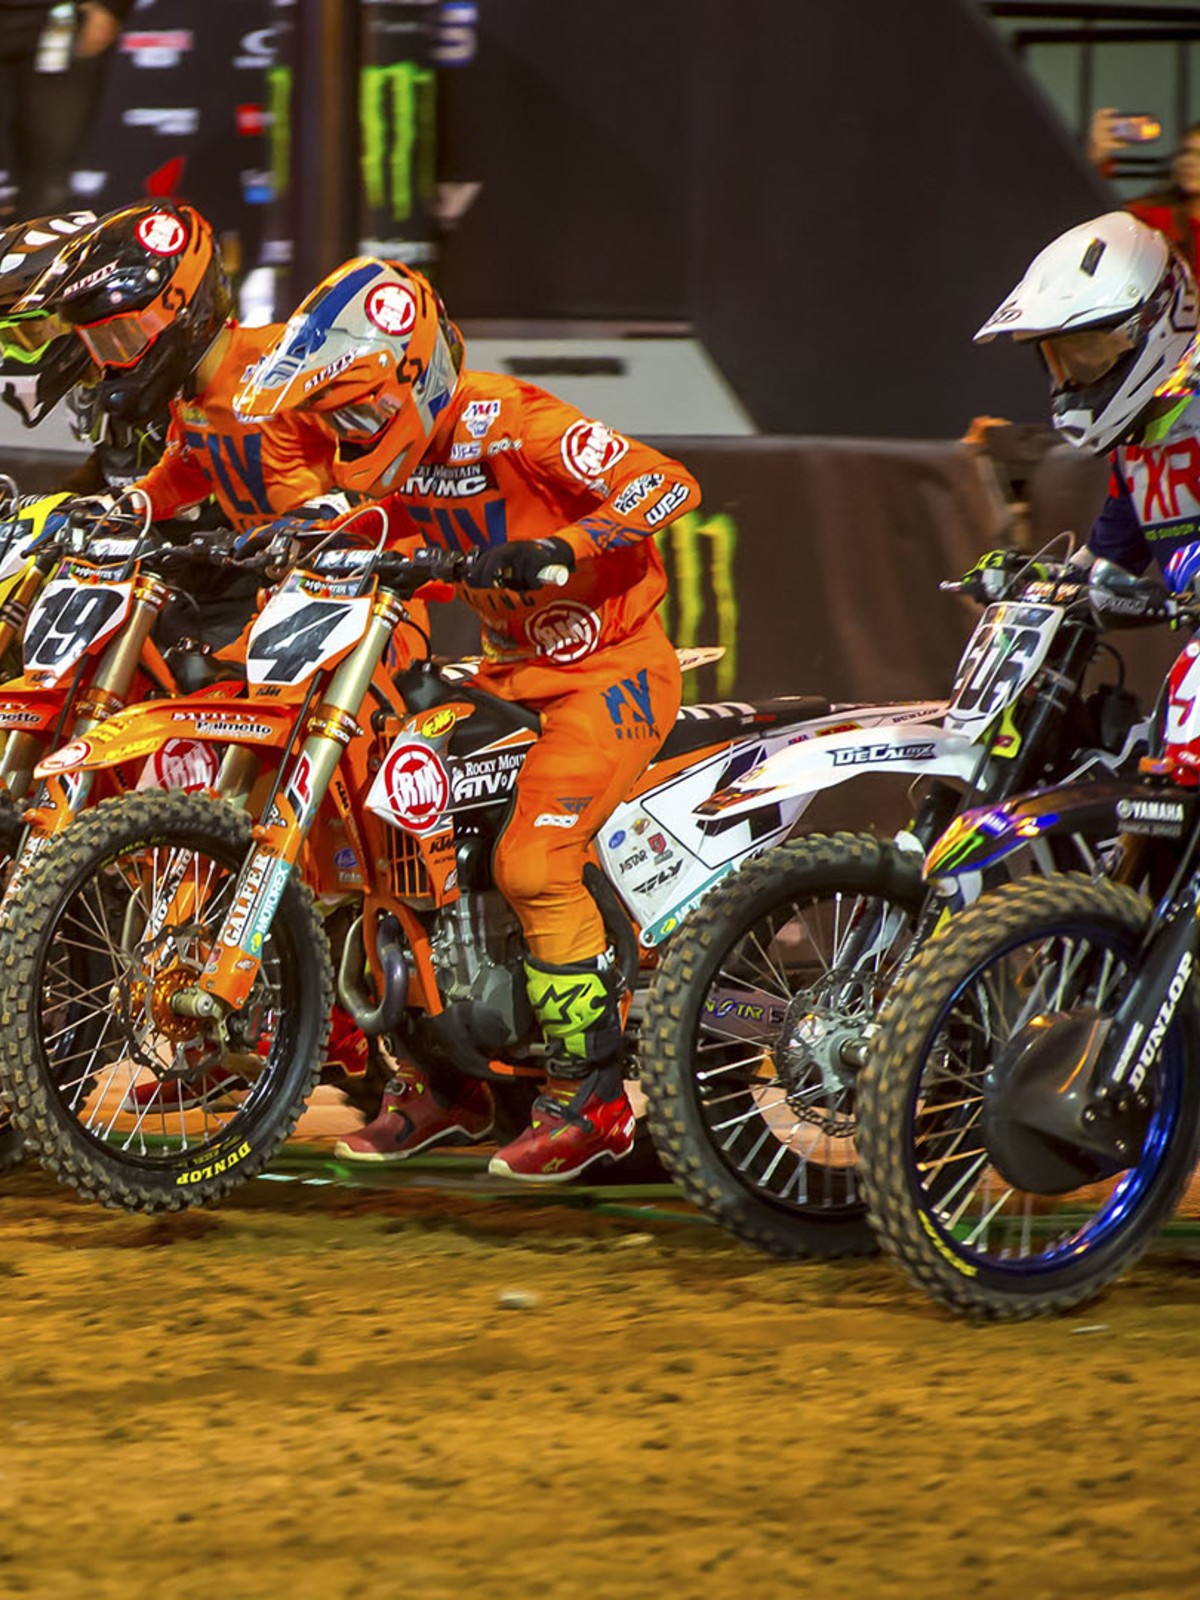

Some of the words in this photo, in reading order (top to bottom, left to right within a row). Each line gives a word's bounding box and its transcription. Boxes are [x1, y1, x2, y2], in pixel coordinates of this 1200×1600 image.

[645, 482, 690, 525] WPS
[26, 586, 125, 665] 19
[247, 601, 355, 683] 4
[195, 721, 272, 735] Palmetto
[1132, 801, 1184, 822] YAMAHA
[254, 864, 290, 935] MOTOREX
[1128, 950, 1193, 1093] DUNLOP
[175, 1140, 252, 1186] DUNLOP
